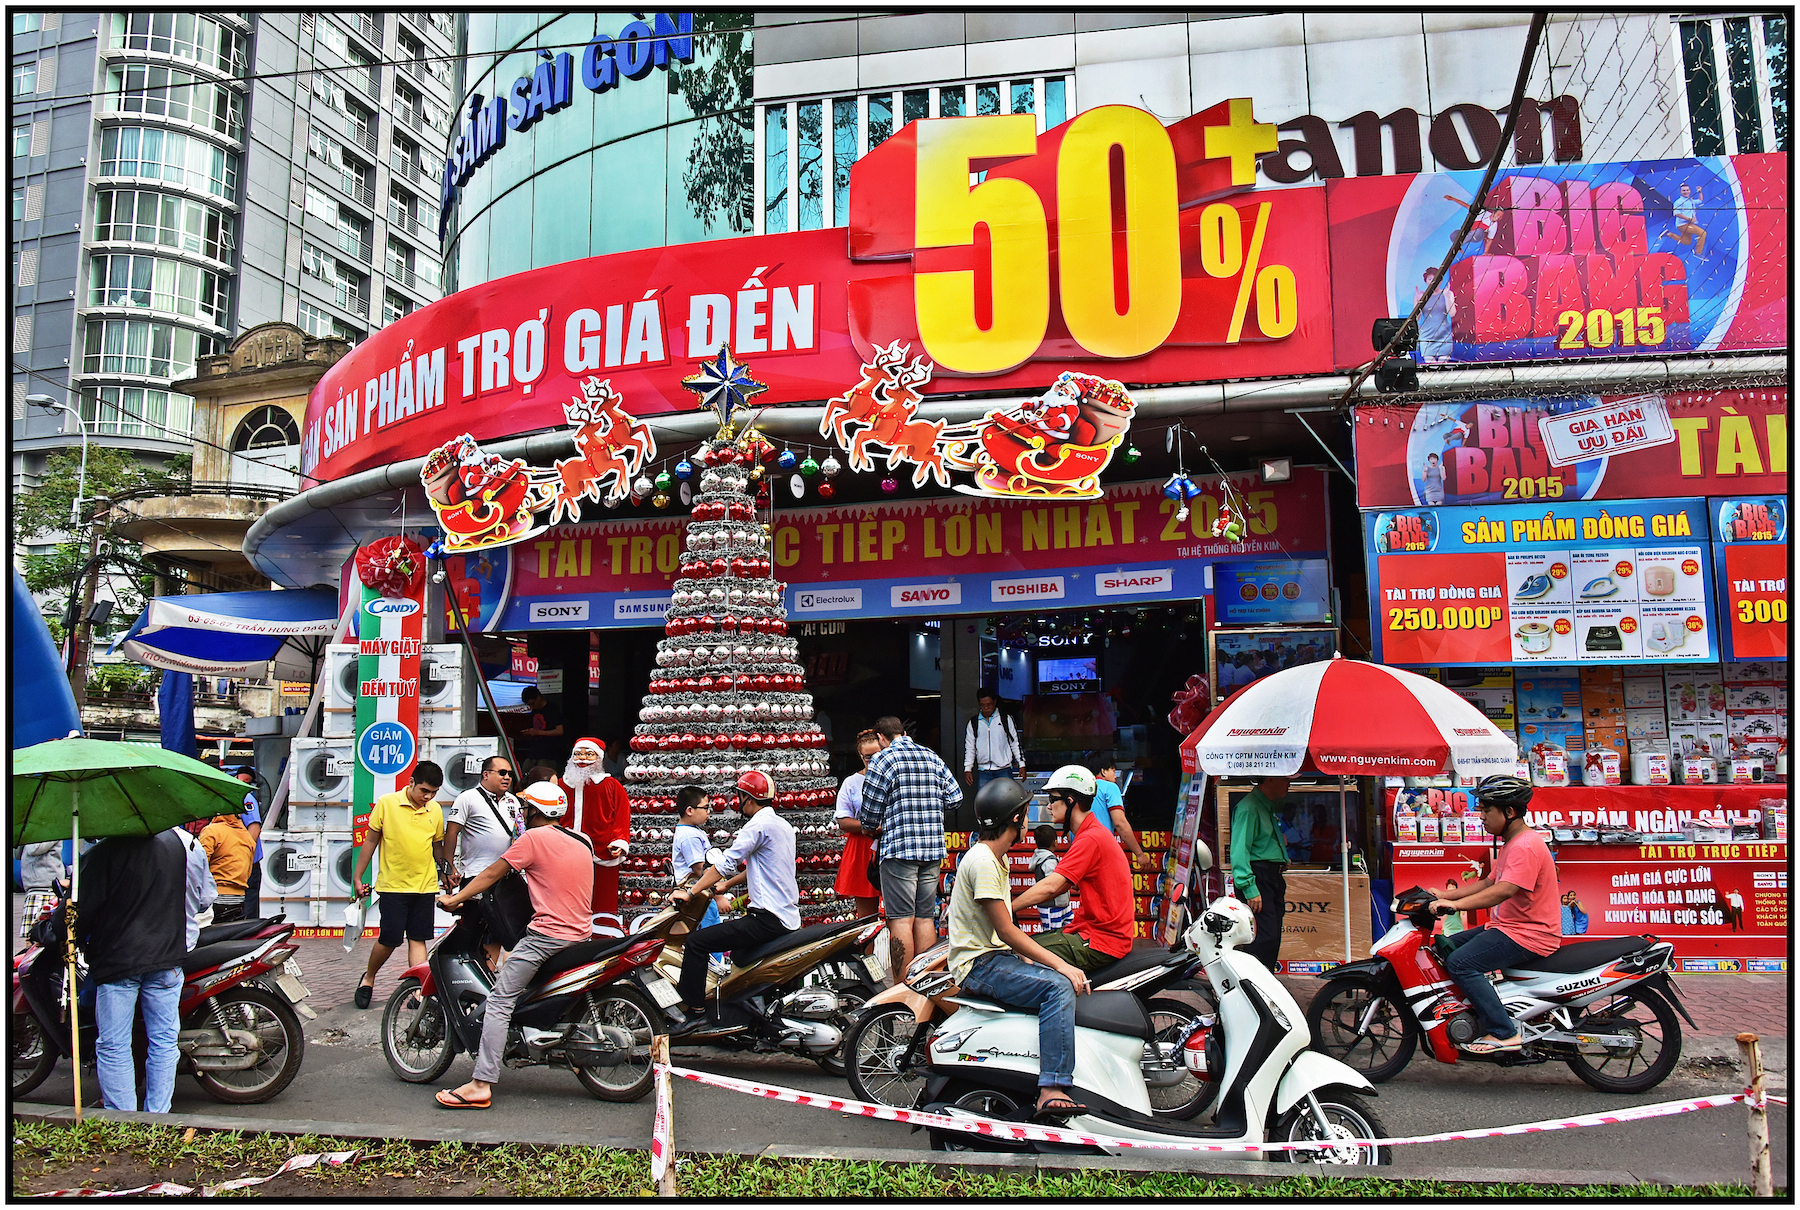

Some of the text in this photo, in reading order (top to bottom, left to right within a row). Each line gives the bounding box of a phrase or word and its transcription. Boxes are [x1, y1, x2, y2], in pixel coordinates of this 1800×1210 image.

[506, 50, 574, 133] SÀI
[1256, 94, 1584, 184] anon
[1508, 175, 1647, 257] BIG
[1472, 254, 1690, 343] BANG
[1556, 306, 1667, 350] 2015
[323, 266, 817, 457] SẢN PHẨM TRỢ GIÁ ĐẾN
[1568, 407, 1644, 438] GIA HẠN
[1075, 453, 1100, 462] SONY
[1503, 476, 1564, 499] 2015
[446, 510, 464, 521] SONY
[1741, 502, 1769, 522] BIG
[1396, 514, 1423, 533] BIG
[1461, 509, 1692, 545] SẢN PHẨM ĐỒNG GIÁ
[534, 538, 592, 579] TÀI
[607, 528, 681, 580] TRỢ
[1159, 490, 1278, 542] 205
[1751, 531, 1773, 541] 2015
[1264, 541, 1280, 550] KIM
[1405, 542, 1426, 551] 2015
[1551, 568, 1567, 577] 29%
[1617, 567, 1632, 575] 29%
[1683, 565, 1698, 573] 29%
[998, 582, 1059, 596] TOSHIBA
[1104, 576, 1163, 589] SHARP
[1733, 578, 1786, 594] TÀI TRỢ
[816, 595, 856, 605] Electrolux
[900, 587, 950, 602] SANYO
[1385, 584, 1503, 602] TÀI TRỢ ĐỒNG GIÁ
[368, 600, 419, 614] CANDY
[537, 606, 582, 617] SONY
[188, 614, 233, 628] 63-65-67
[236, 623, 266, 632] TRẦN
[1555, 624, 1571, 632] 36%
[1621, 622, 1636, 631] 36%
[1687, 621, 1703, 629] 36%
[361, 678, 387, 697] ĐẾN
[1051, 682, 1088, 692] SONY
[370, 728, 402, 741] GIẢM
[368, 744, 405, 765] 41%
[1205, 752, 1224, 761] CÔNG
[1254, 749, 1283, 759] NGUYỄN
[1284, 751, 1297, 759] KIM
[1320, 753, 1437, 768] www.nguyenkim.com
[1635, 806, 1692, 833] NGÀN
[1639, 843, 1778, 860] TÀI TRỢ TRỰC TIẾP
[1611, 865, 1712, 888] GIẢM GIÁ CỰC LỚN
[1609, 888, 1716, 906] HÀNG HÓA ĐA DẠNG
[1755, 898, 1776, 906] THỐNG
[1604, 905, 1724, 926] KHUYẾN MÃI CỰC SỐC
[298, 927, 315, 937] TIẾP
[1717, 961, 1737, 971] 10%
[1555, 976, 1602, 994] SUZUKI
